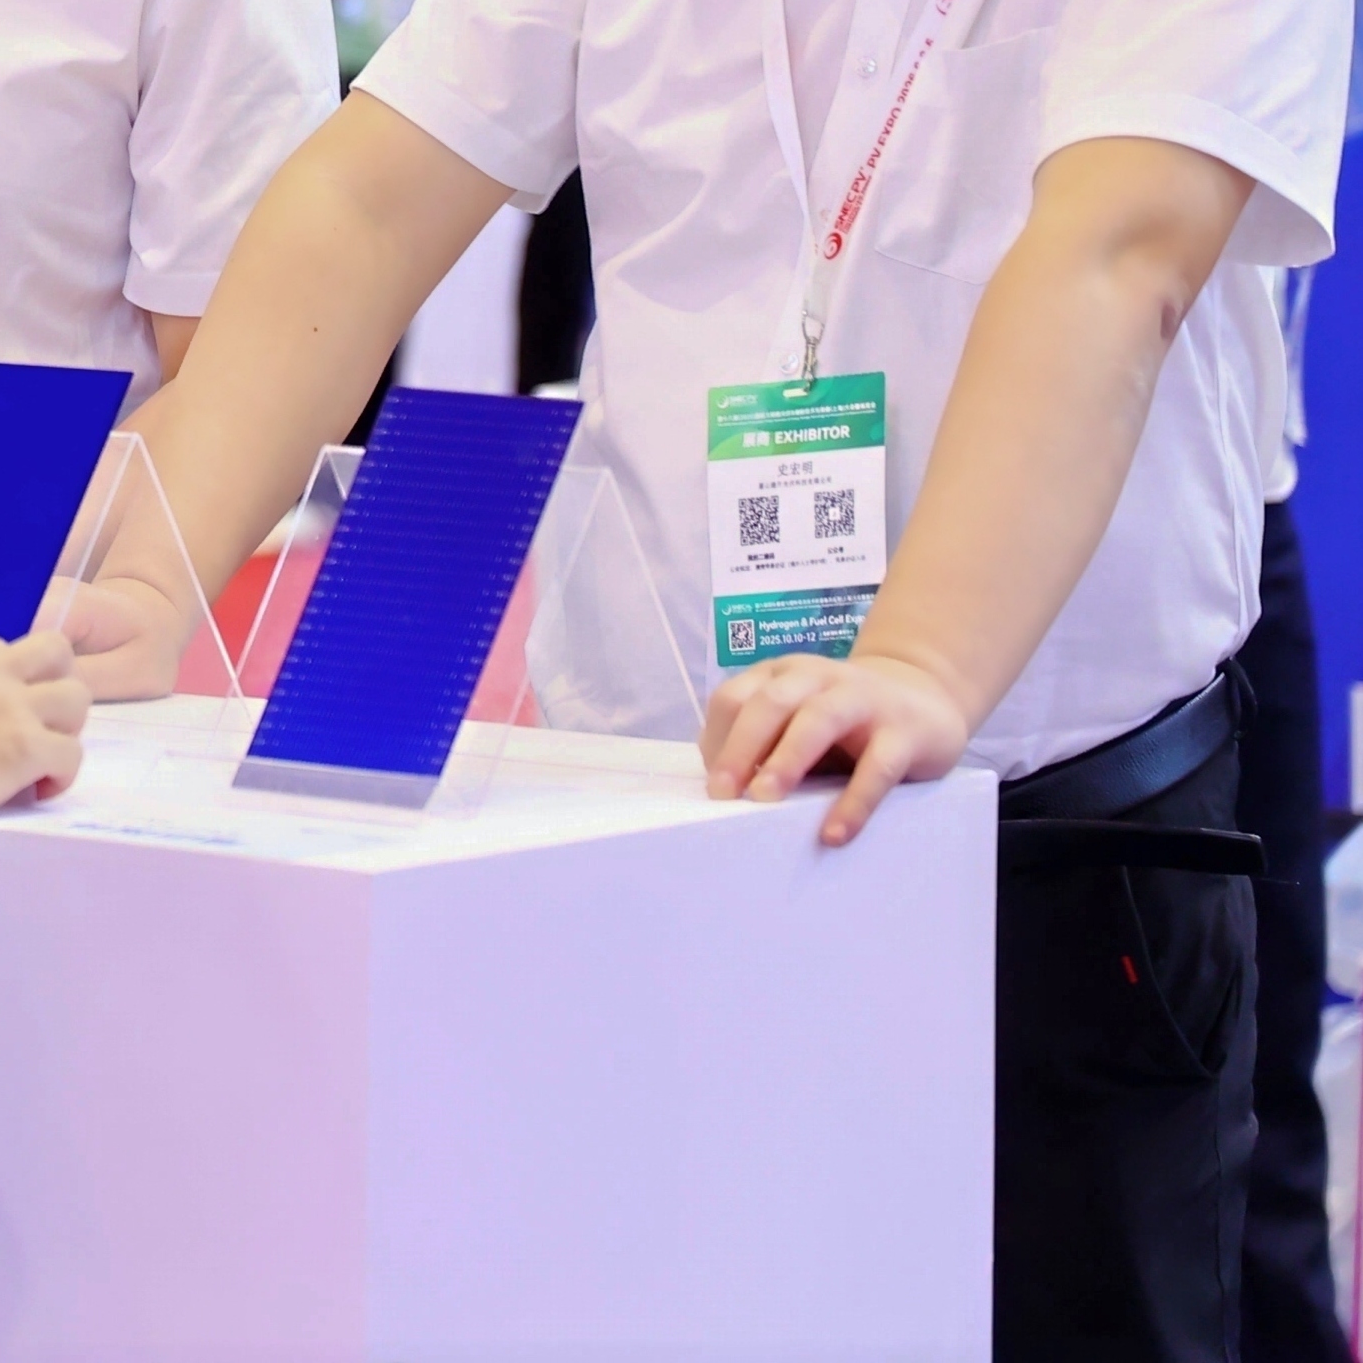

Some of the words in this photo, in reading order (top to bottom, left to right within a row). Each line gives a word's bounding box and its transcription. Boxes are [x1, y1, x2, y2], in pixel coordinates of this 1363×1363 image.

[867, 147, 882, 169] PV
[877, 107, 902, 147] EXPO
[774, 424, 851, 445] EXHIBITOR
[758, 619, 800, 633] Hydrogen
[801, 619, 809, 628] &
[809, 616, 828, 627] Fuel
[829, 614, 845, 625] Cell
[760, 632, 817, 646] 2025.10.10-12
